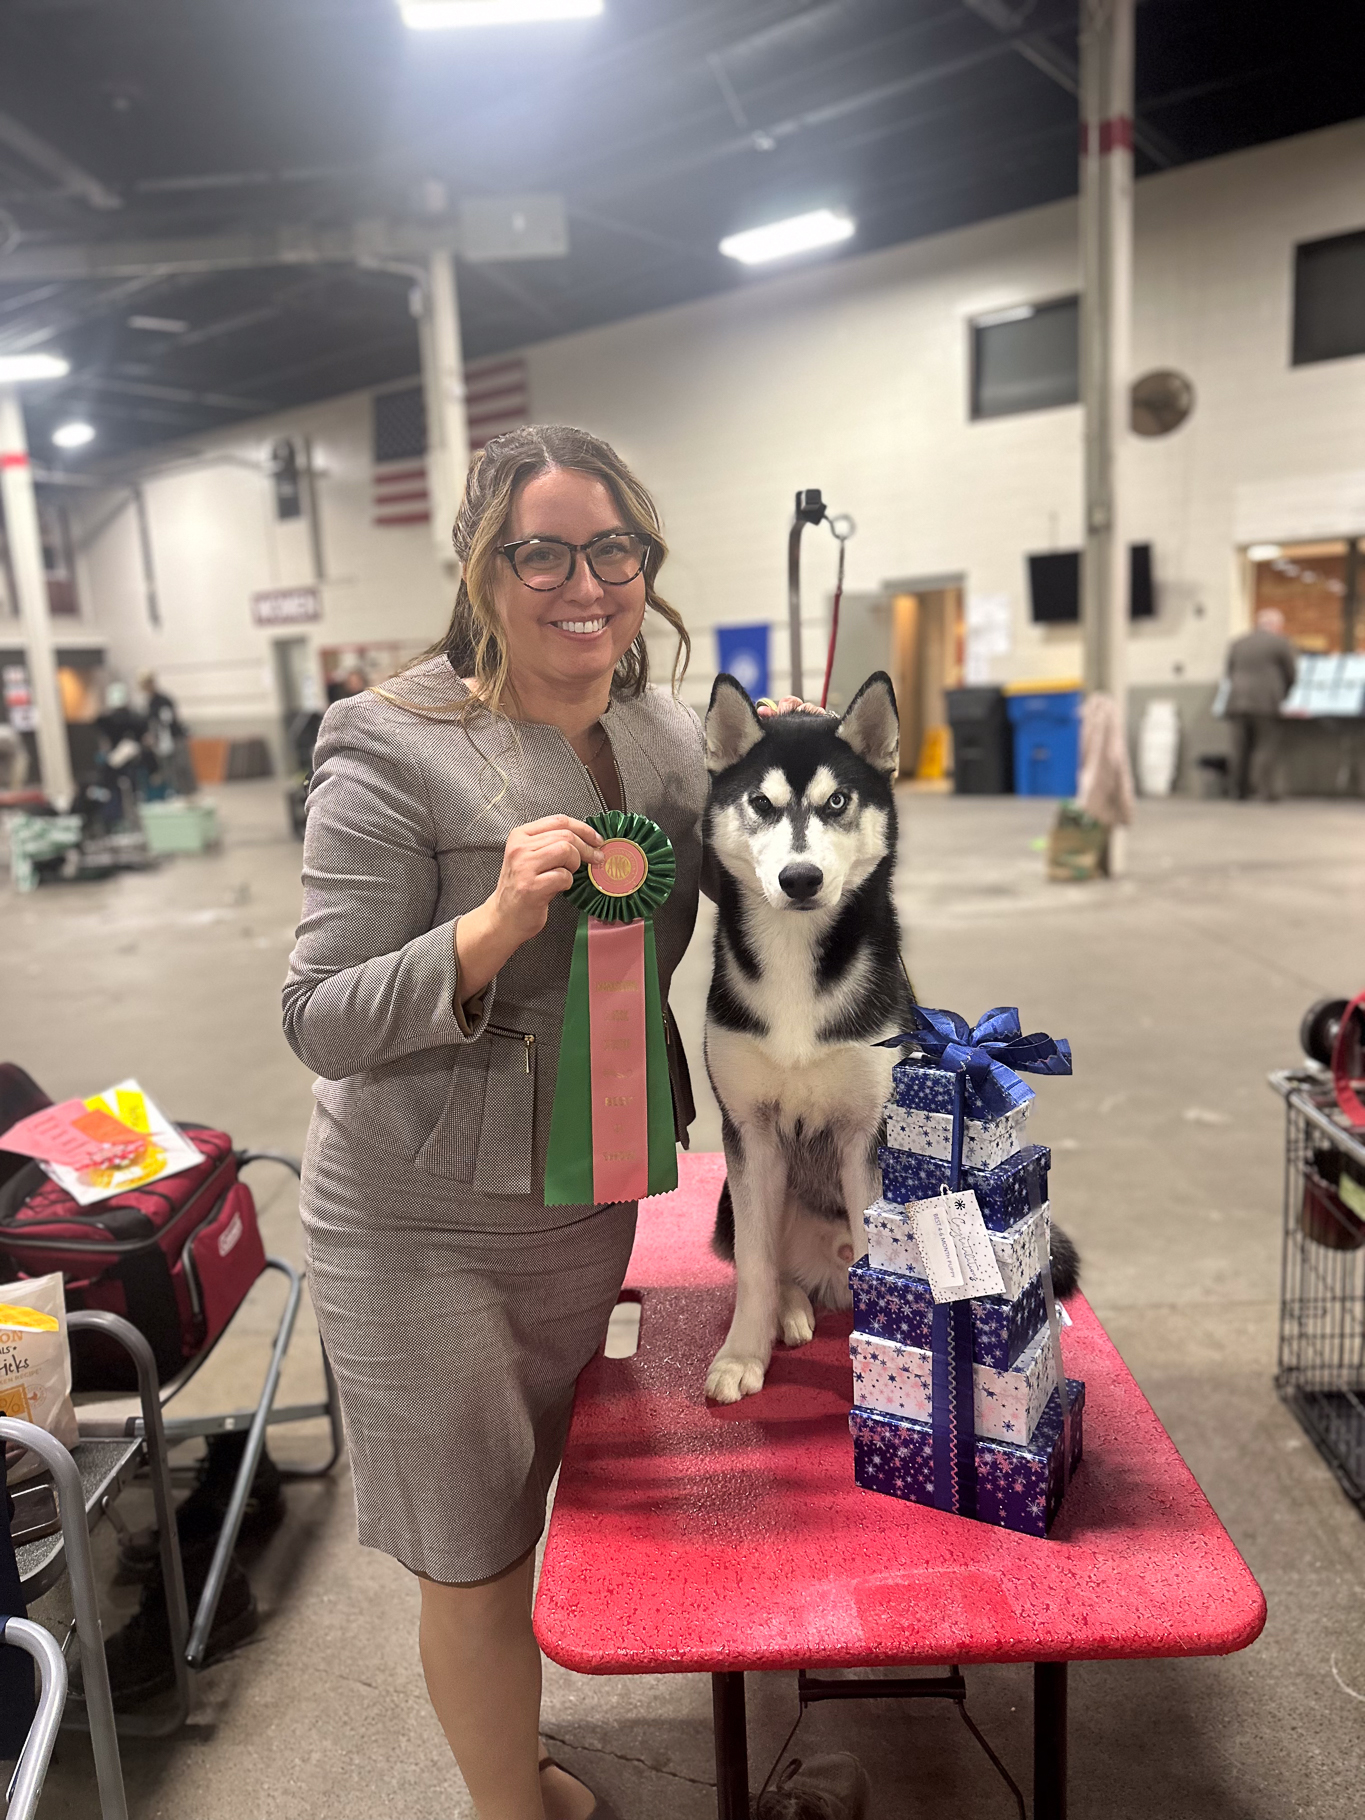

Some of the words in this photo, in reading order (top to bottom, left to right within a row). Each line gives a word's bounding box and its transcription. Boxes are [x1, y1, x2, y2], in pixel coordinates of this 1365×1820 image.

[606, 855, 631, 880] AKC
[933, 1213, 941, 1226] BEST
[940, 1237, 950, 1259] MONTH
[947, 1260, 955, 1278] PUPPY
[0, 1354, 30, 1376] icks
